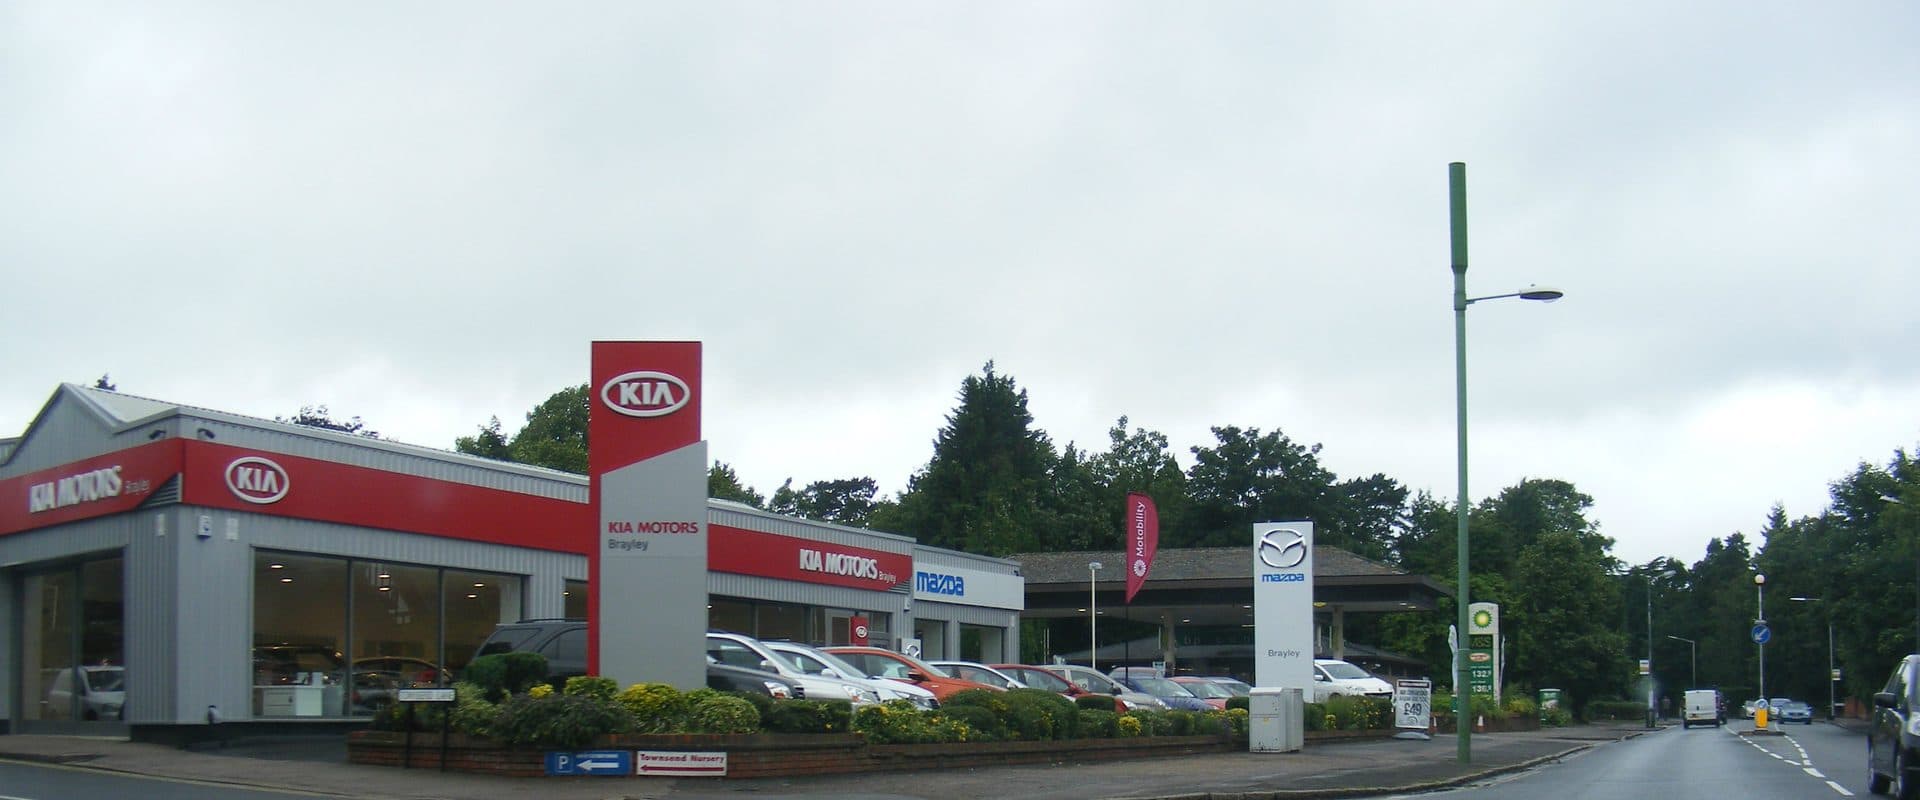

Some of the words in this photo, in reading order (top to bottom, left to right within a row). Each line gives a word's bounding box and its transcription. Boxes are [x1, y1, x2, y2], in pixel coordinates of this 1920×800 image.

[618, 382, 675, 406] KIA
[236, 466, 279, 494] KIA
[30, 482, 56, 513] KIA
[57, 465, 122, 507] MOTORS
[607, 521, 633, 534] KIA
[637, 521, 699, 534] MOTORS
[1135, 501, 1146, 558] Motability
[607, 538, 649, 552] Brayley
[799, 548, 823, 572] KIA
[825, 552, 878, 580] MOTORS
[1267, 648, 1301, 659] Brayley
[1403, 702, 1422, 716] £49
[558, 755, 569, 770] P
[640, 753, 687, 762] Townsend
[690, 754, 725, 764] Nursery
